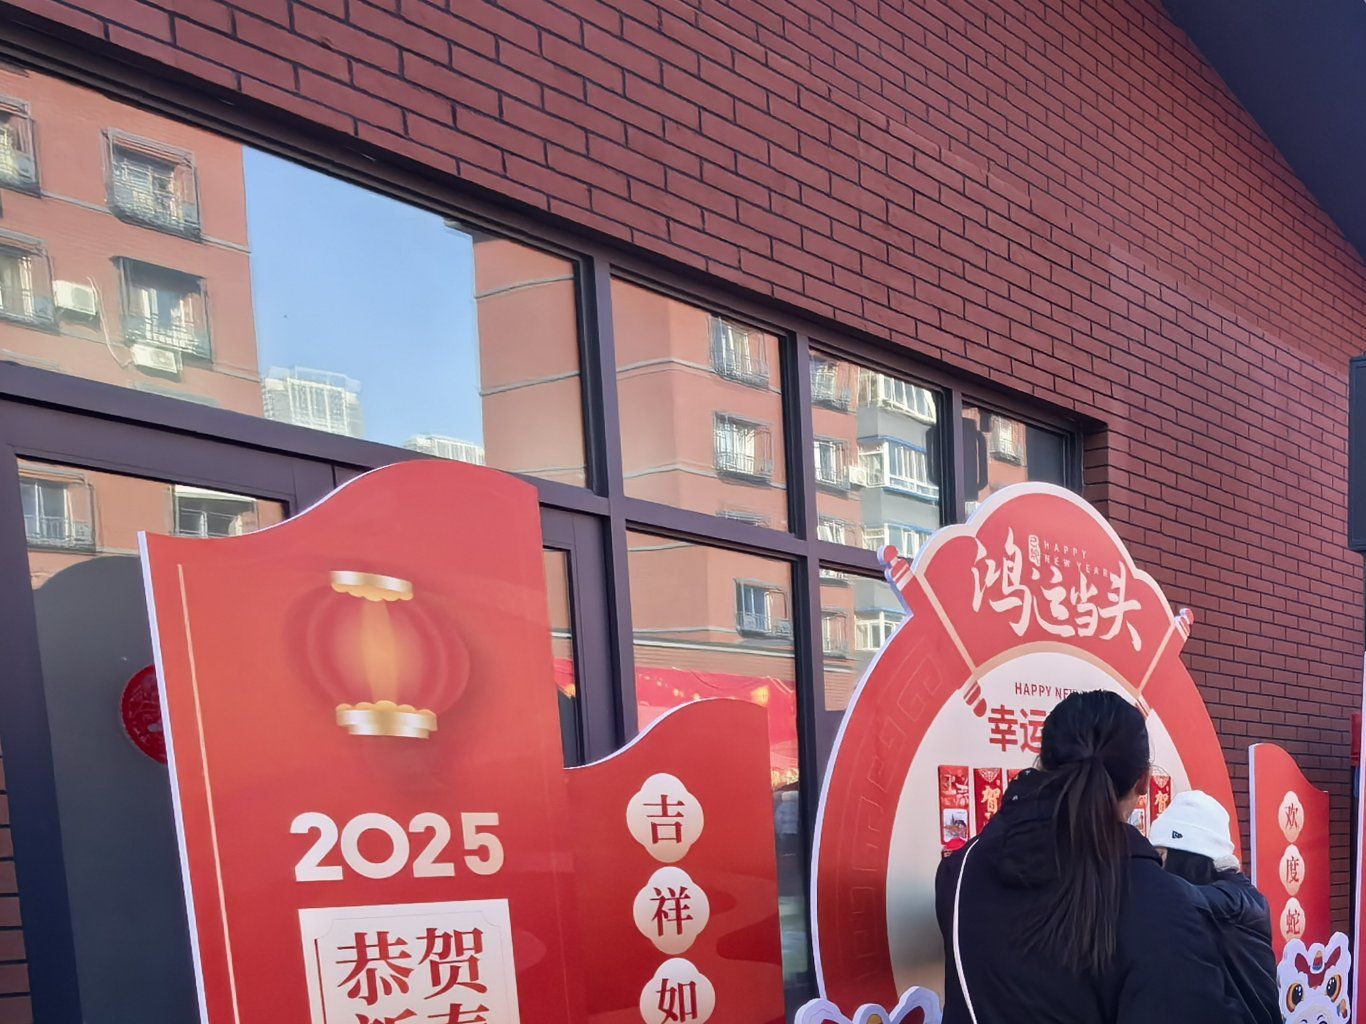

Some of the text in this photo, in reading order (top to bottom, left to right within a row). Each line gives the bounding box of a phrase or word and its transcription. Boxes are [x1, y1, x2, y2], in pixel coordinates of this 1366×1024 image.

[1043, 540, 1087, 559] HAPPY
[1044, 553, 1108, 577] NEW YEAR
[971, 526, 1142, 652] 鸿运当头
[1014, 682, 1079, 700] HAPPY NE
[289, 811, 504, 882] 2025
[1284, 803, 1300, 936] 欢度蛇
[336, 927, 488, 1007] 恭贺
